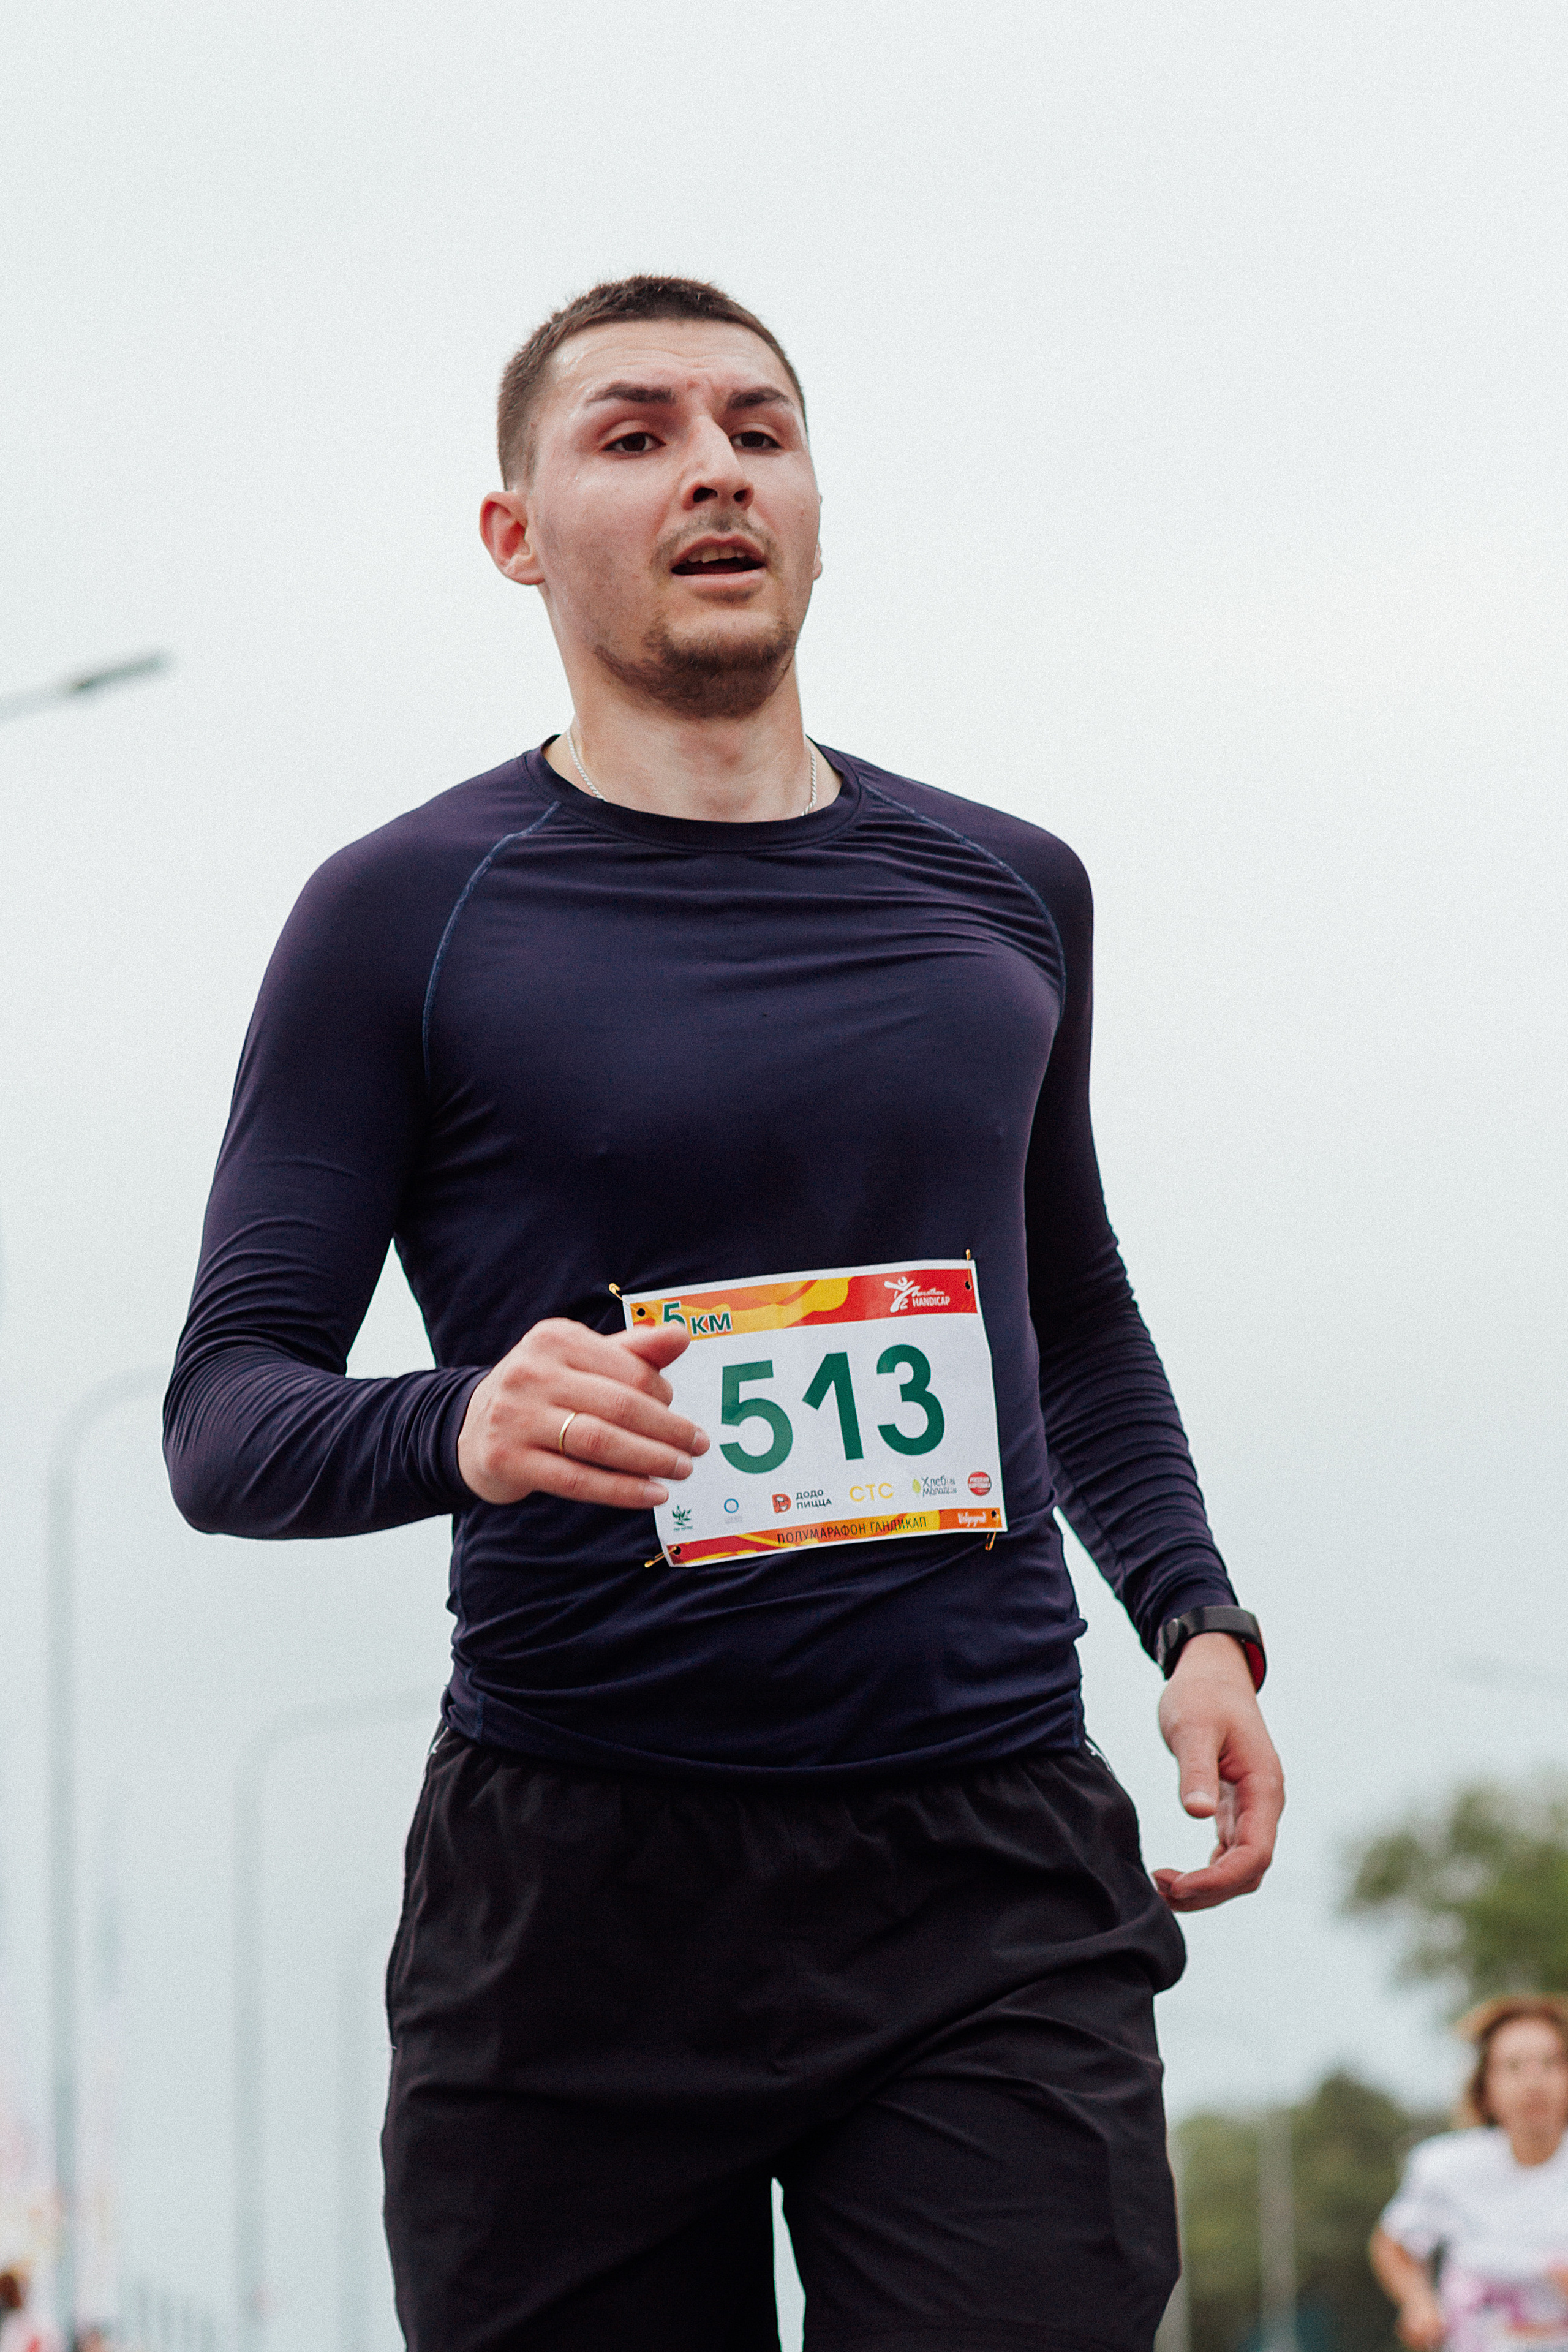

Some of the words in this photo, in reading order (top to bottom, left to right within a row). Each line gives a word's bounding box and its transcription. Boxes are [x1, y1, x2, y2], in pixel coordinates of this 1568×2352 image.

[912, 1295, 950, 1307] HANDICAP
[719, 1344, 945, 1474] 513
[796, 1489, 824, 1500] ДОДО
[796, 1499, 832, 1510] ПИЦЦА
[777, 1523, 867, 1545] ПОЛУМАРАФОН
[870, 1516, 927, 1534] ГАНДИКАП
